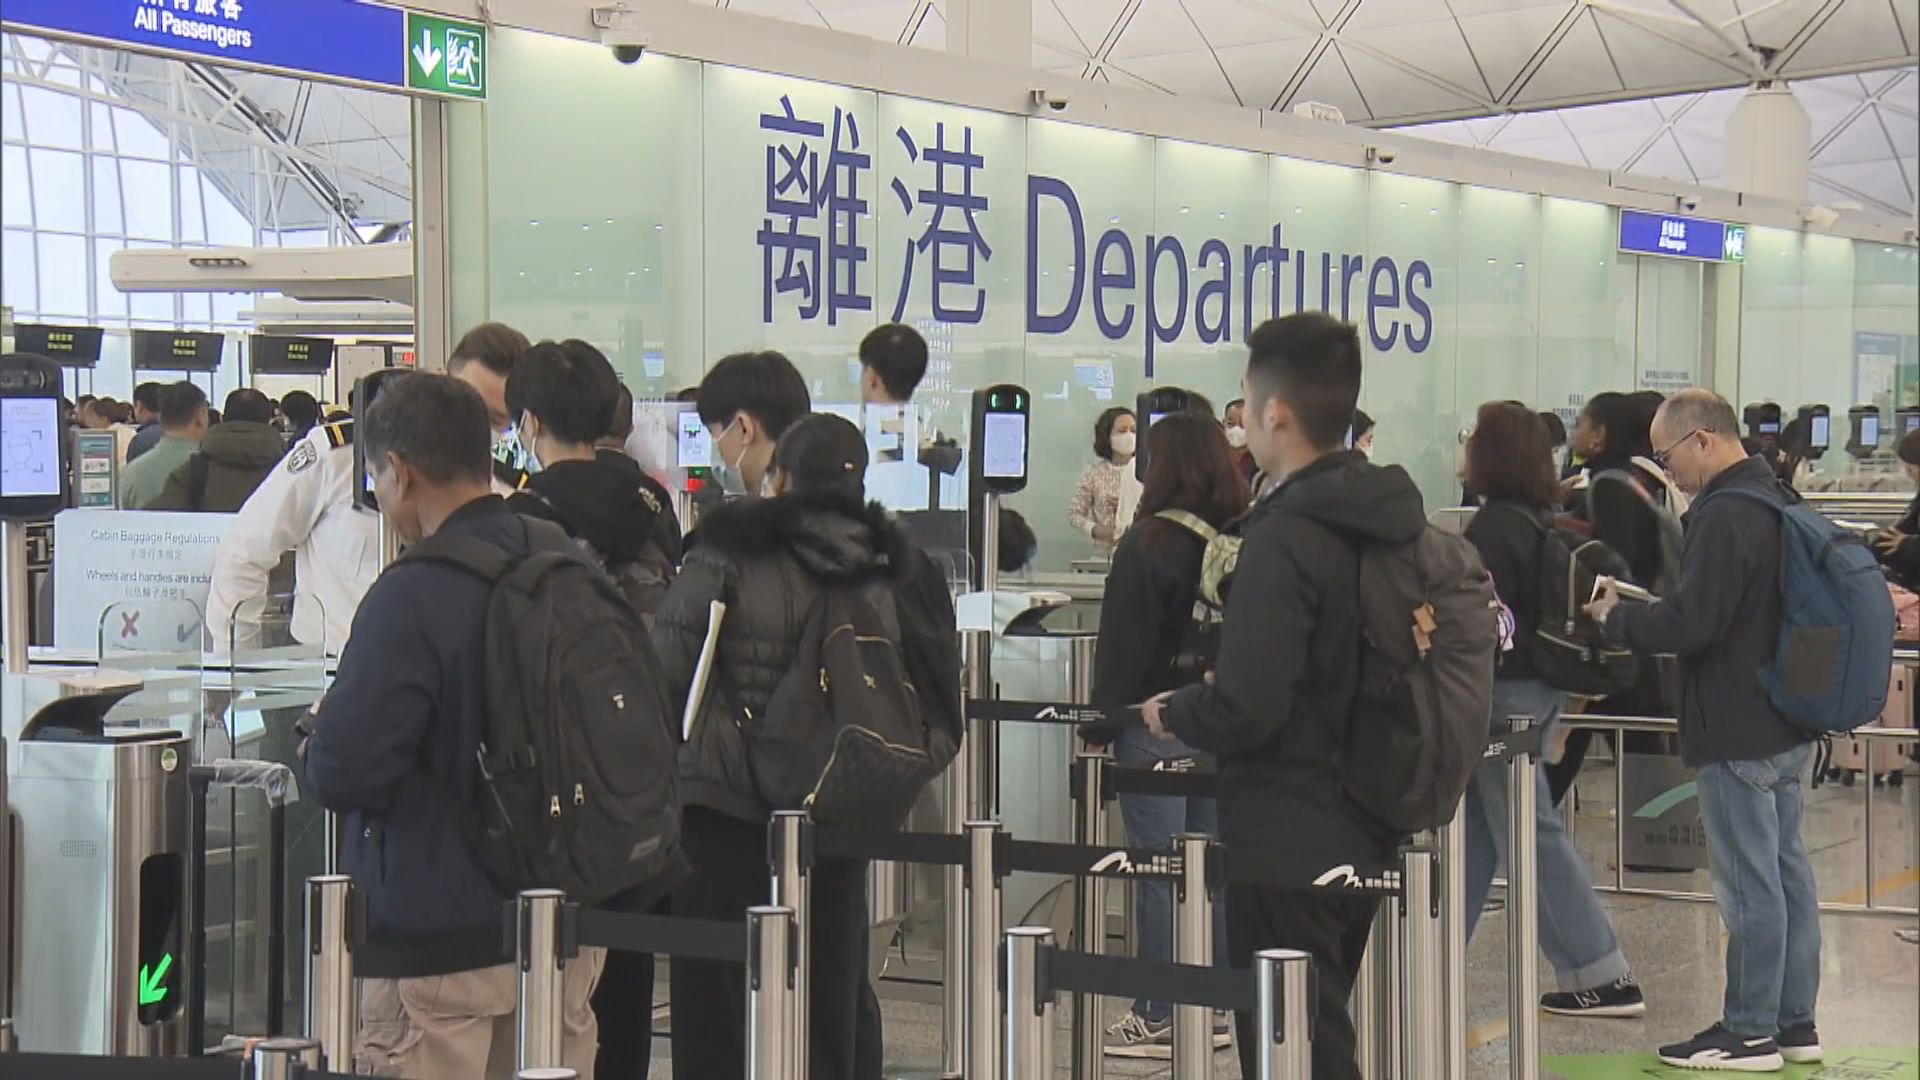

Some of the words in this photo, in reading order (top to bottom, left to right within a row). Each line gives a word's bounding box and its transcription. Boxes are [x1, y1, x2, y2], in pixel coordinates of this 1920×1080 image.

[144, 0, 243, 21] 旅客
[133, 6, 158, 32] All
[161, 10, 252, 49] Passengers
[757, 95, 991, 326] 離港
[1026, 173, 1433, 378] Departures
[91, 530, 119, 541] Cabin
[120, 530, 163, 545] Baggage
[165, 532, 220, 545] Regulations
[86, 569, 119, 581] Wheels
[120, 571, 137, 581] and
[138, 571, 173, 583] handles
[174, 575, 189, 583] are
